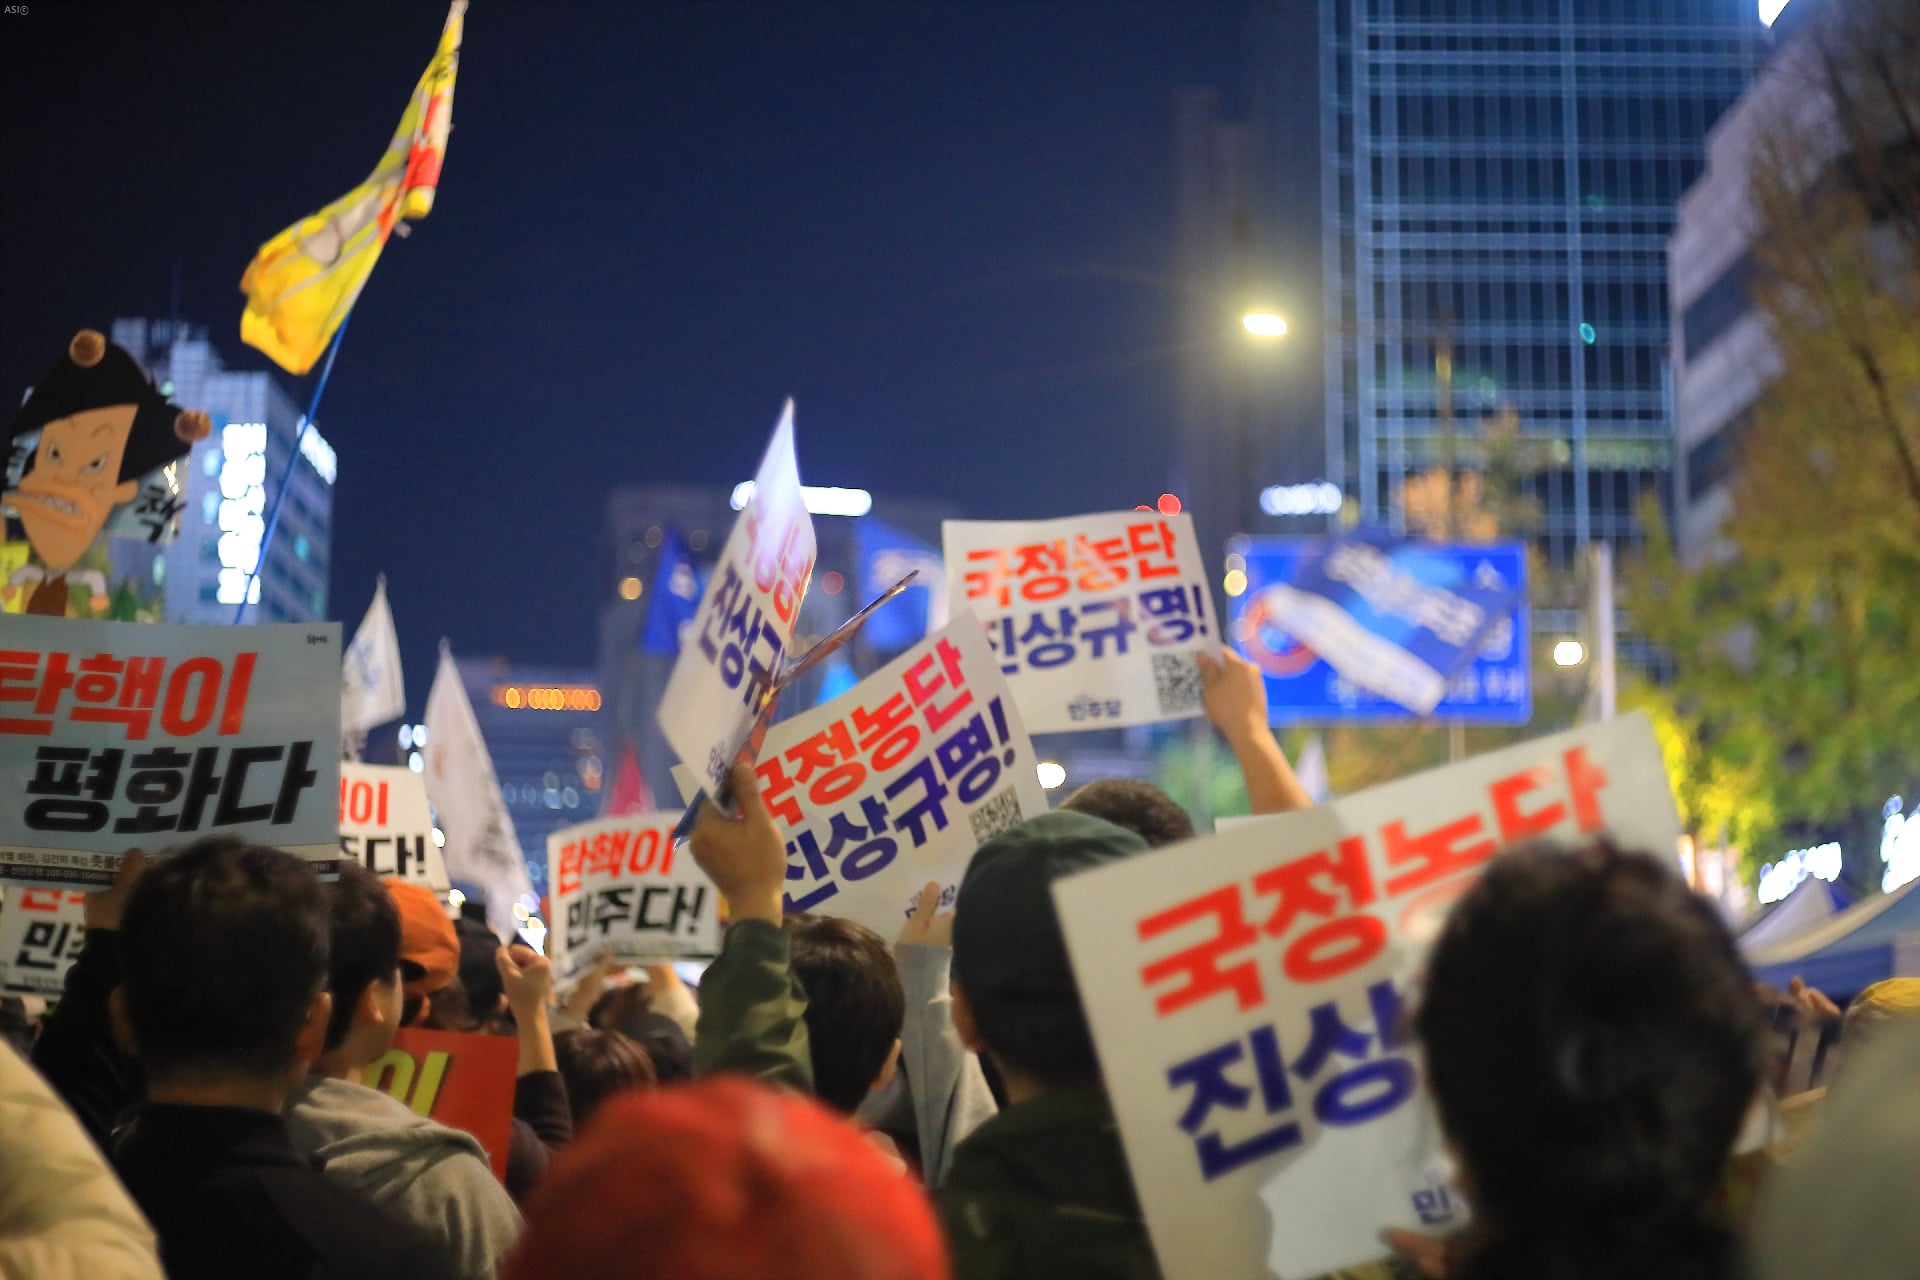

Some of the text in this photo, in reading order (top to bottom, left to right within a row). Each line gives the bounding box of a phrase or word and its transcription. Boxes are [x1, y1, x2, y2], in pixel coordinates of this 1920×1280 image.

[964, 521, 1180, 609] 국정농단
[0, 651, 258, 740] 탄핵이
[754, 637, 975, 827] 국정농단
[24, 741, 318, 834] 평화다
[782, 694, 1015, 914] 진상규명!
[559, 826, 677, 897] 탄핵이
[566, 886, 705, 950] 민주다!
